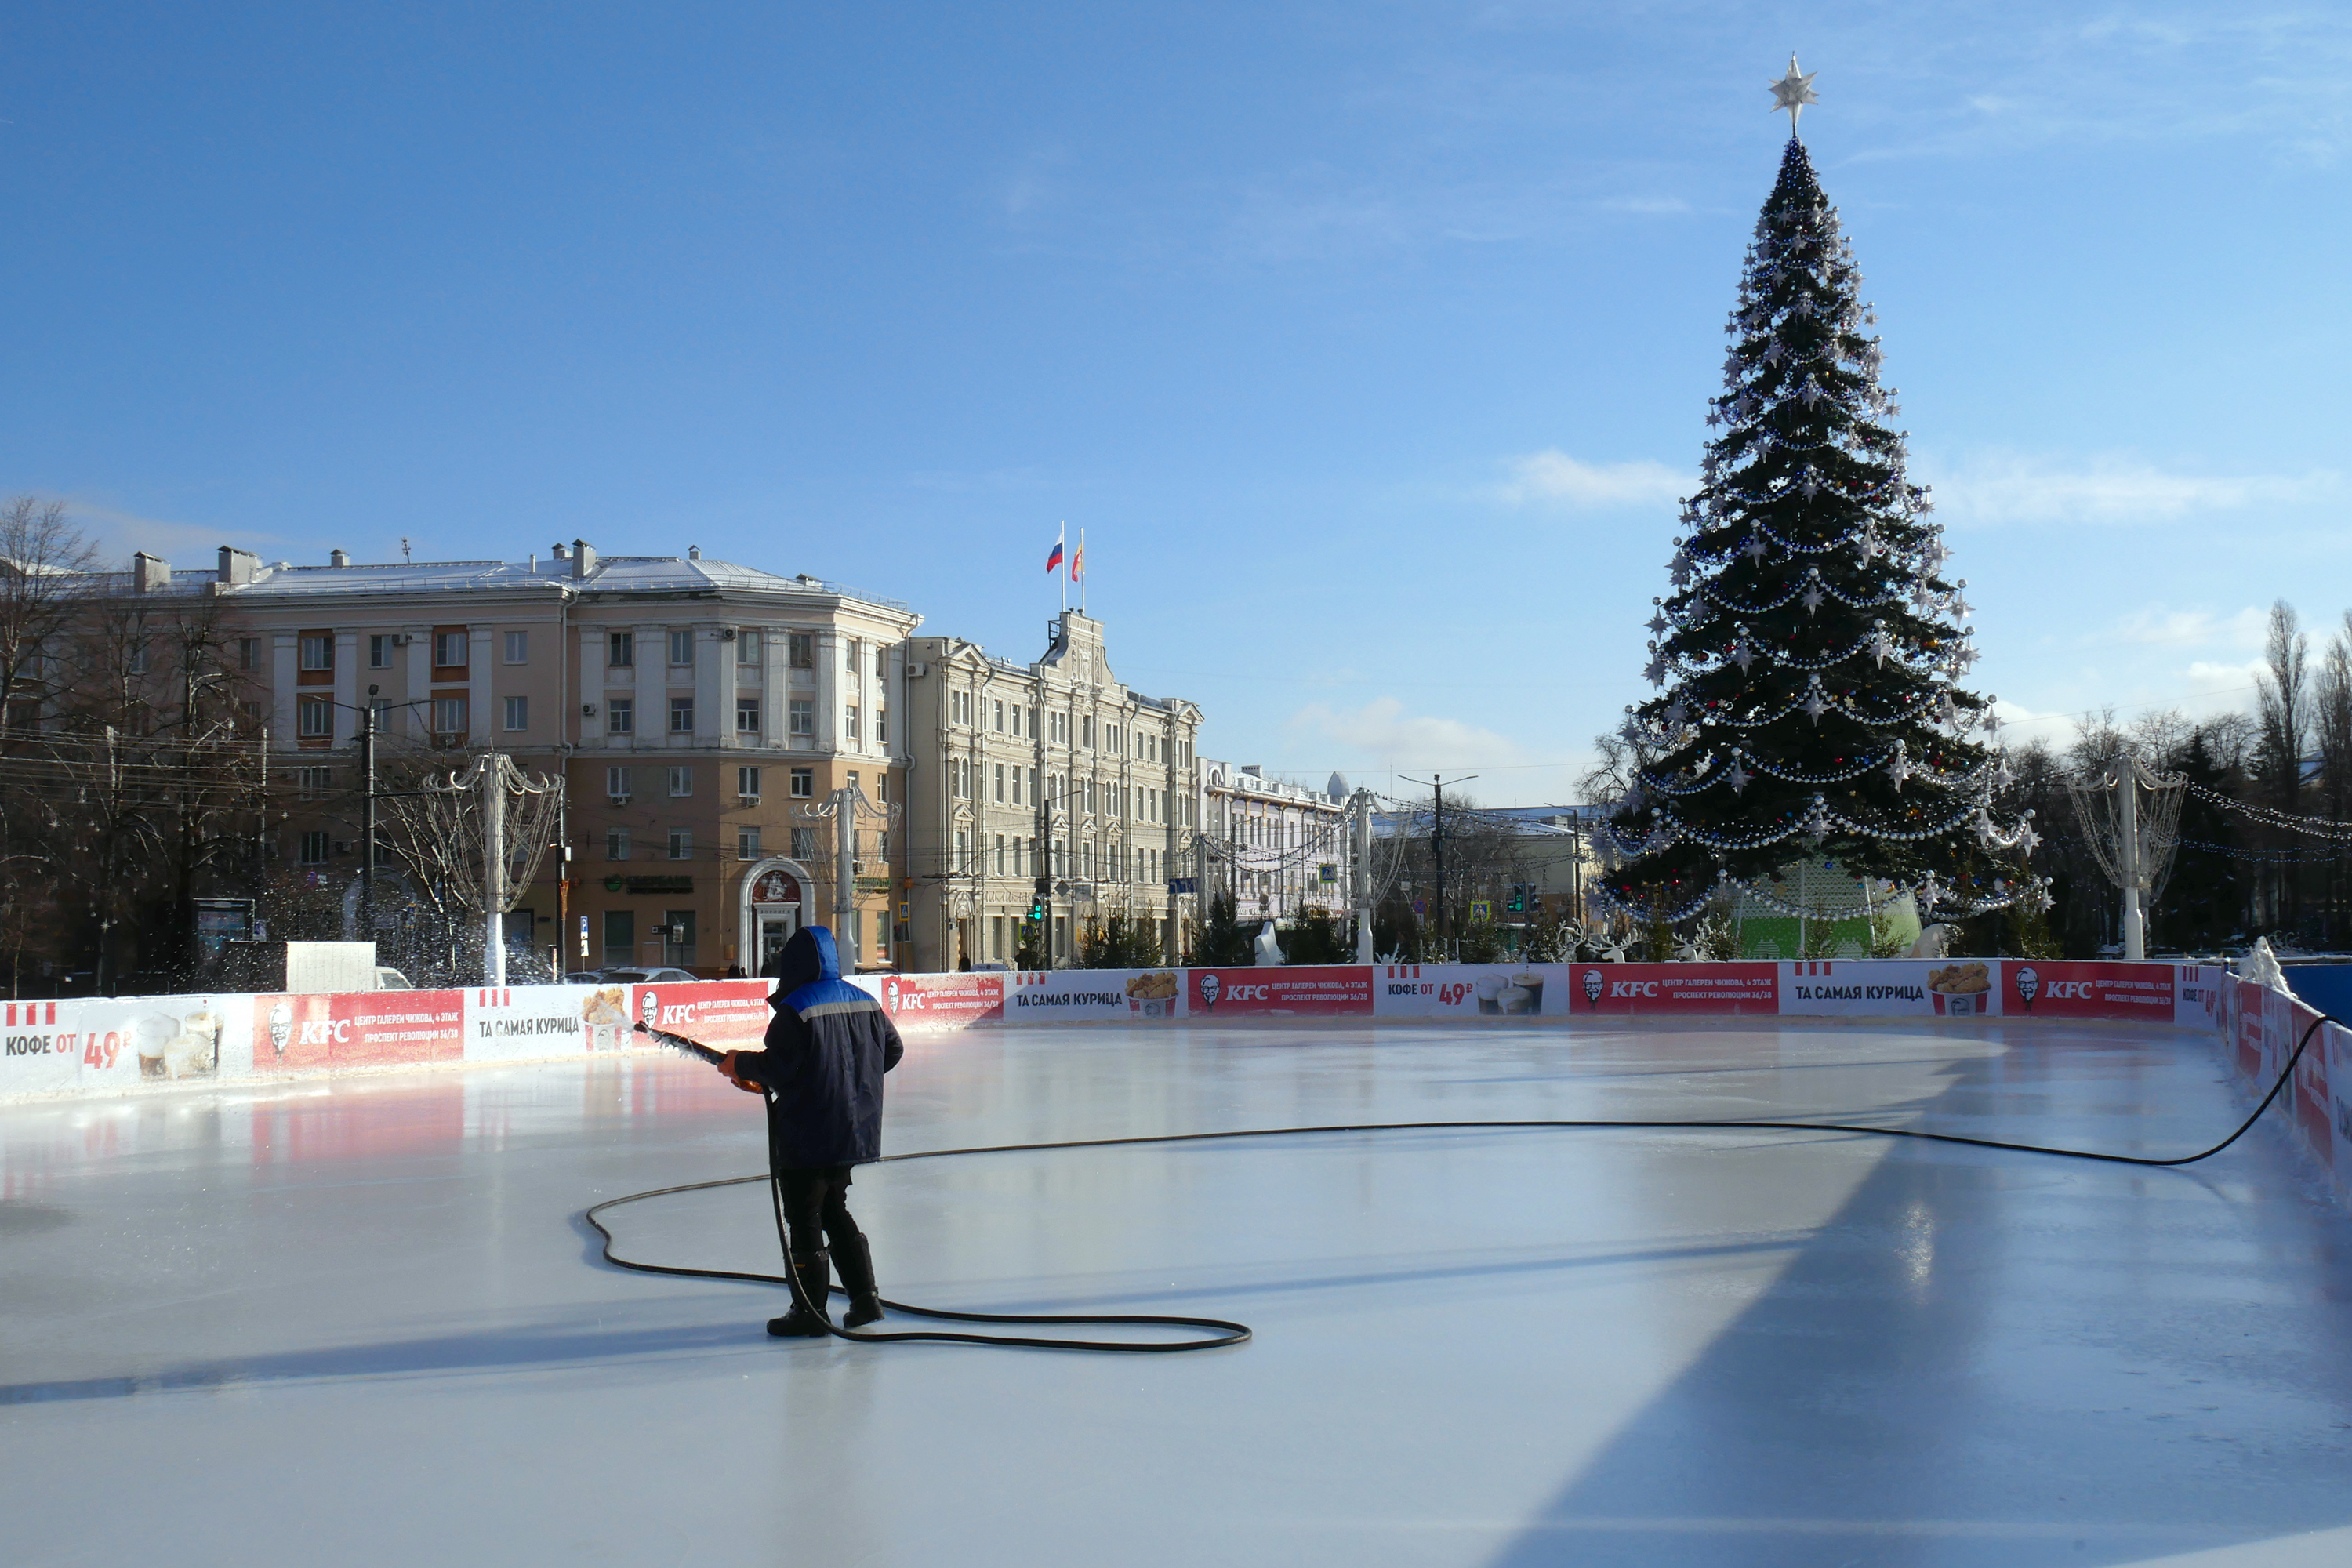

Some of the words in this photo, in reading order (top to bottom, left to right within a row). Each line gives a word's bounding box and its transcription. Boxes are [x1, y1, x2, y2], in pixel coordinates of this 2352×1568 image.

[1317, 982, 1345, 990] ЧИЖОВА,
[1388, 983, 1417, 995] КОФЕ
[1421, 983, 1434, 995] ОТ
[1610, 981, 1658, 998] KFC
[1715, 978, 1745, 988] ЧИЖОВА,
[2045, 981, 2092, 1000] KFC
[1016, 994, 1029, 1007] ТА
[1032, 993, 1070, 1006] САМАЯ
[1073, 993, 1123, 1007] КУРИЦА
[1225, 985, 1269, 1000] KFC
[1312, 993, 1348, 1002] РЕВОЛЮЦИИ
[1350, 993, 1368, 1001] 36/38
[1708, 991, 1751, 1000] РЕВОЛЮЦИИ
[1751, 991, 1772, 1000] 36/38
[1795, 985, 1812, 1000] ТА
[1814, 985, 1862, 1000] САМАЯ
[1866, 985, 1925, 1002] КУРИЦА
[902, 993, 926, 1010] KFC
[354, 1016, 376, 1027] ЦЕНТР
[377, 1014, 405, 1025] ГАЛЕРЕИ
[406, 1013, 434, 1025] ЧИЖОВА,
[435, 1013, 440, 1022] 4
[441, 1012, 458, 1022] ЭТАЖ
[662, 1004, 695, 1025] KFC
[299, 1019, 350, 1045] KFC
[479, 1021, 492, 1037] ТА
[495, 1018, 533, 1036] САМАЯ
[536, 1017, 579, 1036] КУРИЦА
[365, 1032, 398, 1043] ПРОСПЕКТ
[399, 1030, 439, 1042] РЕВОЛЮЦИИ
[440, 1029, 458, 1040] 36/38
[6, 1035, 51, 1056] КОФЕ
[56, 1033, 76, 1053] ОТ
